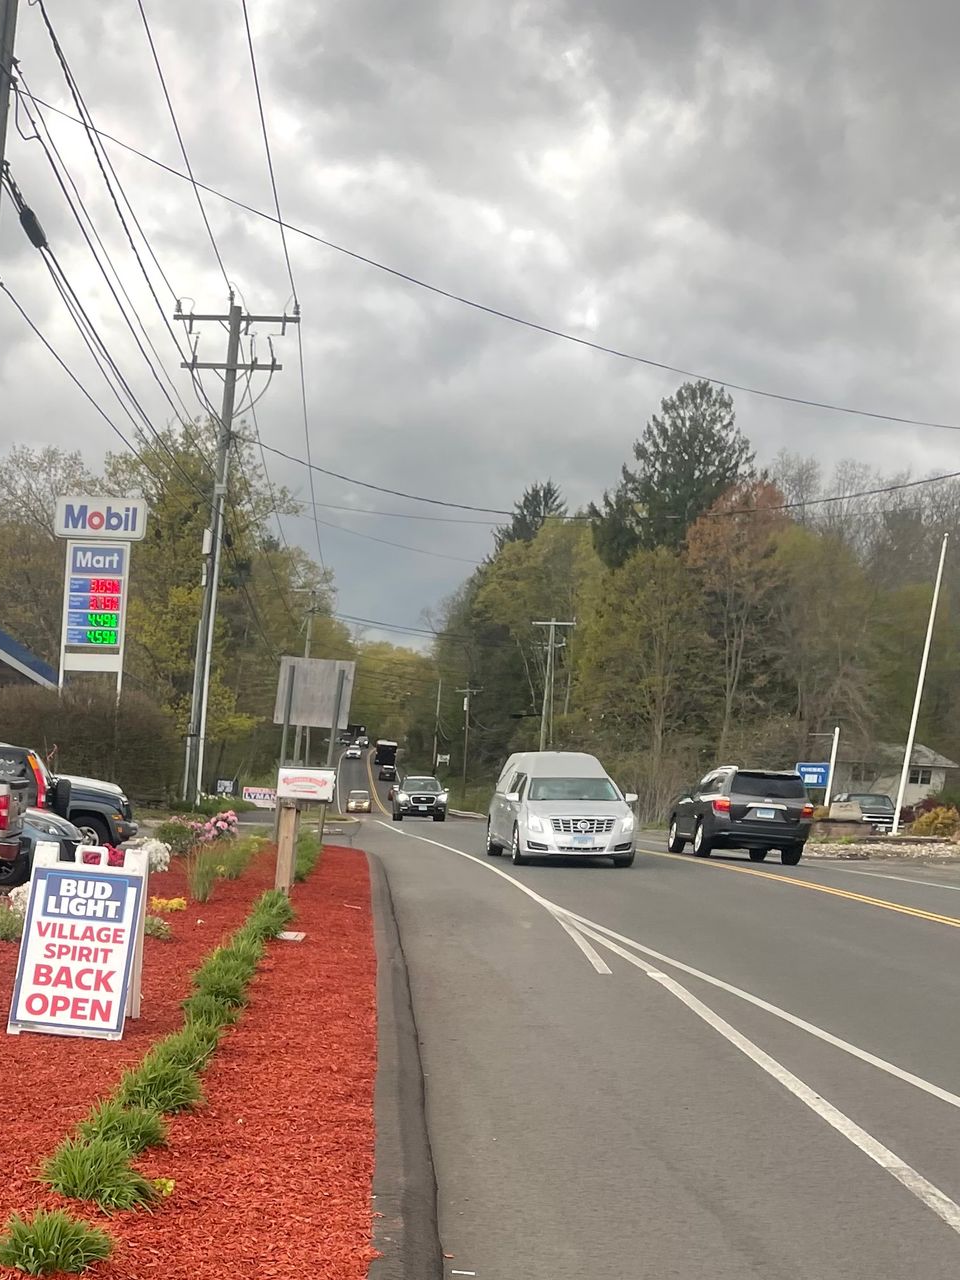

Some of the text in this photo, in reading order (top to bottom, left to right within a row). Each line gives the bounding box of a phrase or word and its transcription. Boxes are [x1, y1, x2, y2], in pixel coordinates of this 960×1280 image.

[64, 504, 137, 532] Mobil
[76, 551, 119, 569] Mart
[59, 878, 113, 900] BUD
[46, 895, 120, 919] LIGHT
[36, 921, 125, 945] VILLAGE
[43, 943, 113, 964] SPIRIT
[32, 963, 117, 993] BACK
[25, 993, 113, 1023] OPEN
